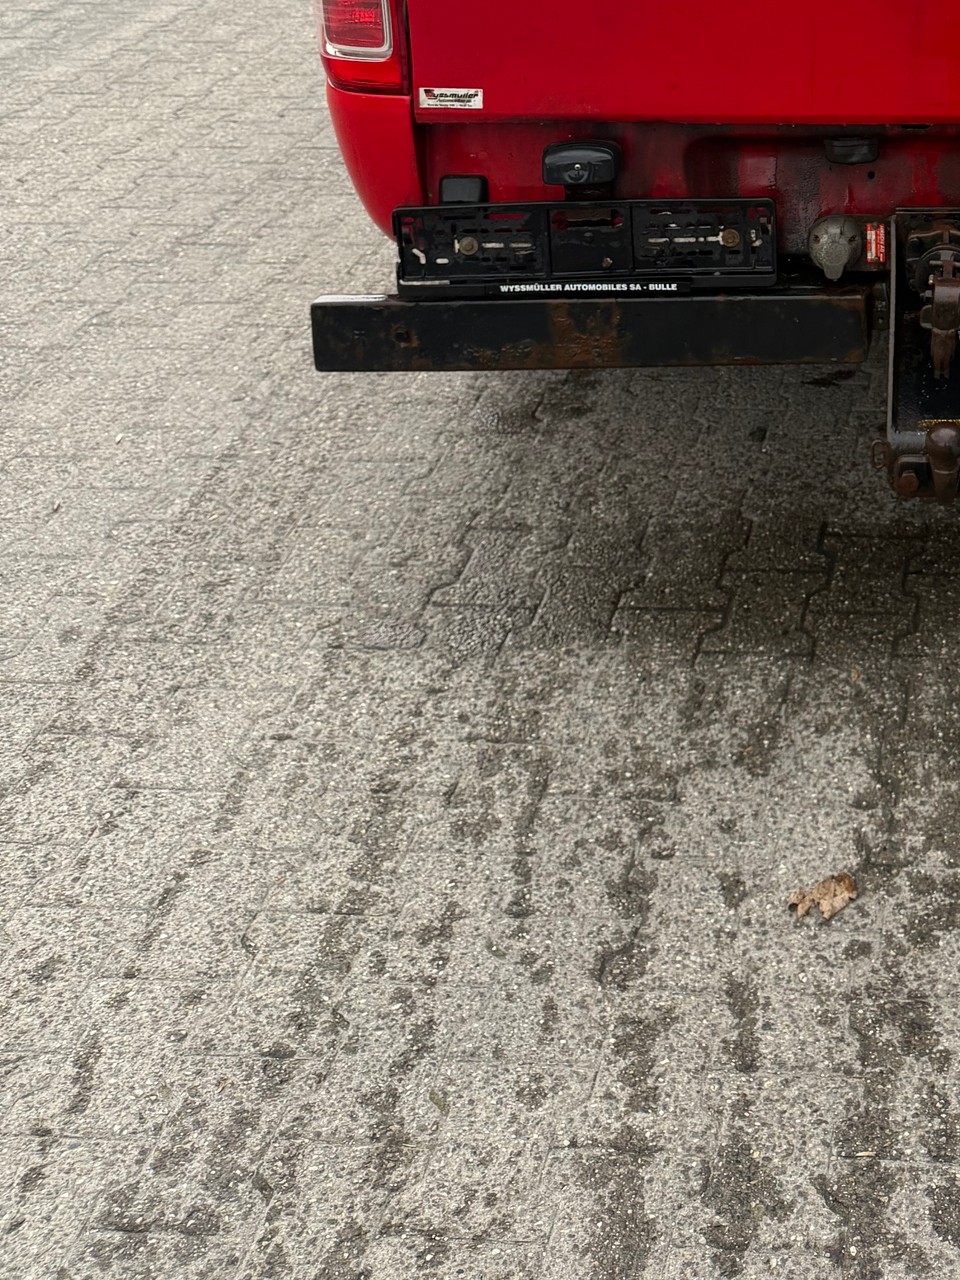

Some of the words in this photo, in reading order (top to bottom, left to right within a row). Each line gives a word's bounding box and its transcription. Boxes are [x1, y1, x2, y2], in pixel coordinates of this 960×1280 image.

[500, 283, 563, 292] WYSSMÜLLER
[564, 283, 628, 291] AUTOMOBILES
[649, 283, 677, 291] BULLE
